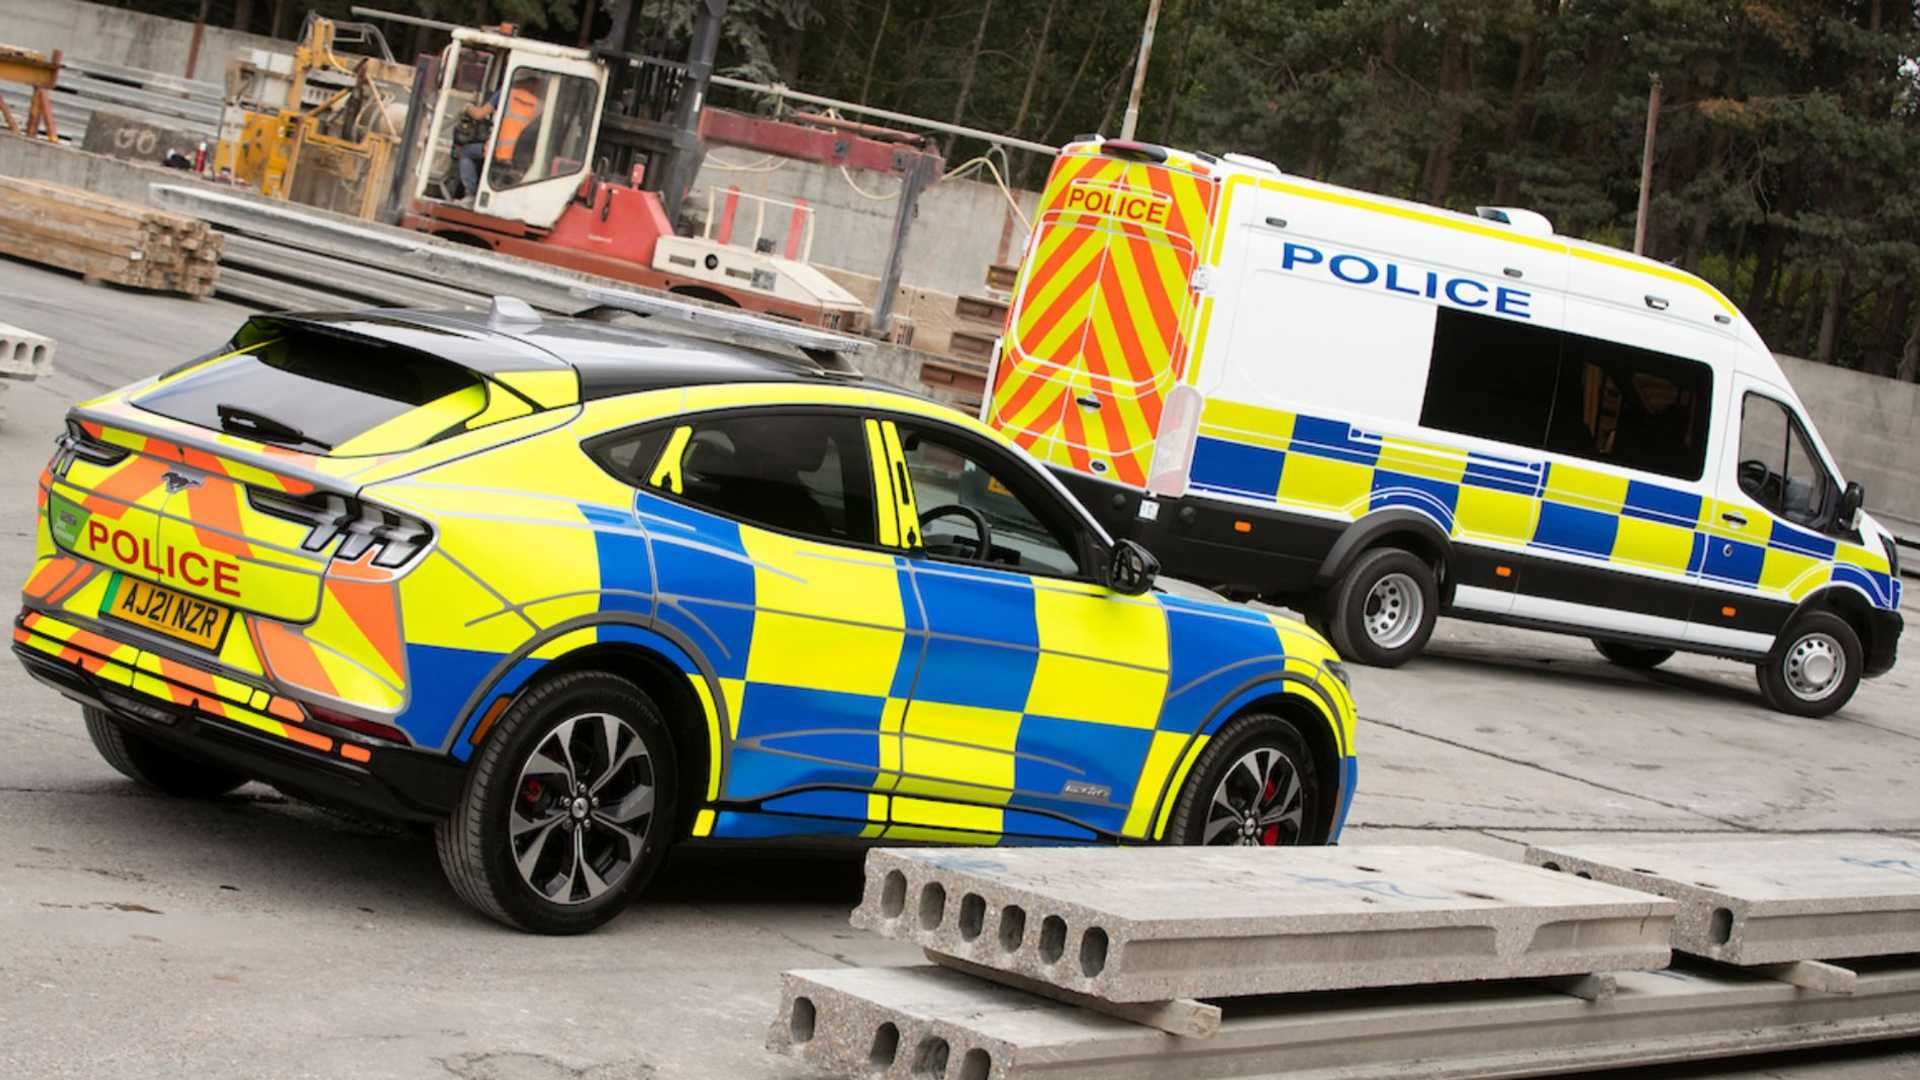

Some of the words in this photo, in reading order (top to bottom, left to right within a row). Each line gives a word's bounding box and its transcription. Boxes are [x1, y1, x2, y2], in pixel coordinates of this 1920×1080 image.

[1068, 188, 1166, 224] POLICE
[1282, 242, 1532, 319] POLICE
[89, 520, 241, 597] POLICE
[122, 583, 174, 622] AJ21
[171, 598, 219, 638] NZR
